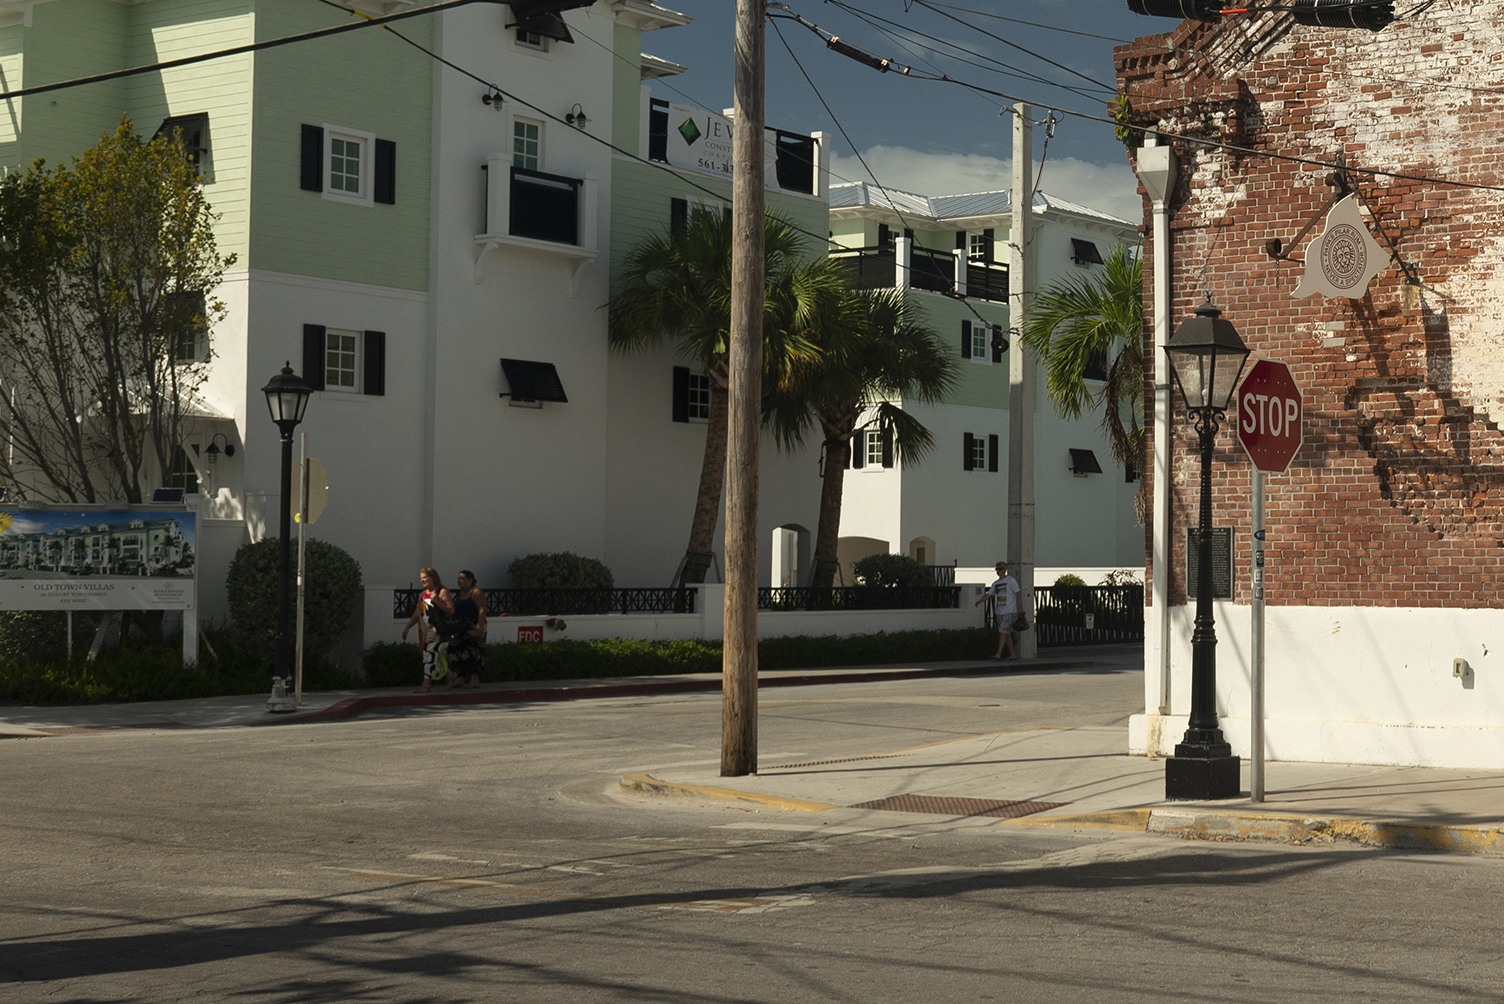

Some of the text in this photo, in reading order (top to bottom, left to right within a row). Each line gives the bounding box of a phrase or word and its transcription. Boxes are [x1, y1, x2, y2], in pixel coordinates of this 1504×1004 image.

[704, 141, 733, 153] CONST
[1242, 392, 1299, 438] STOP
[33, 583, 115, 591] OLD TOWN VILLAS
[518, 630, 540, 644] FDC
